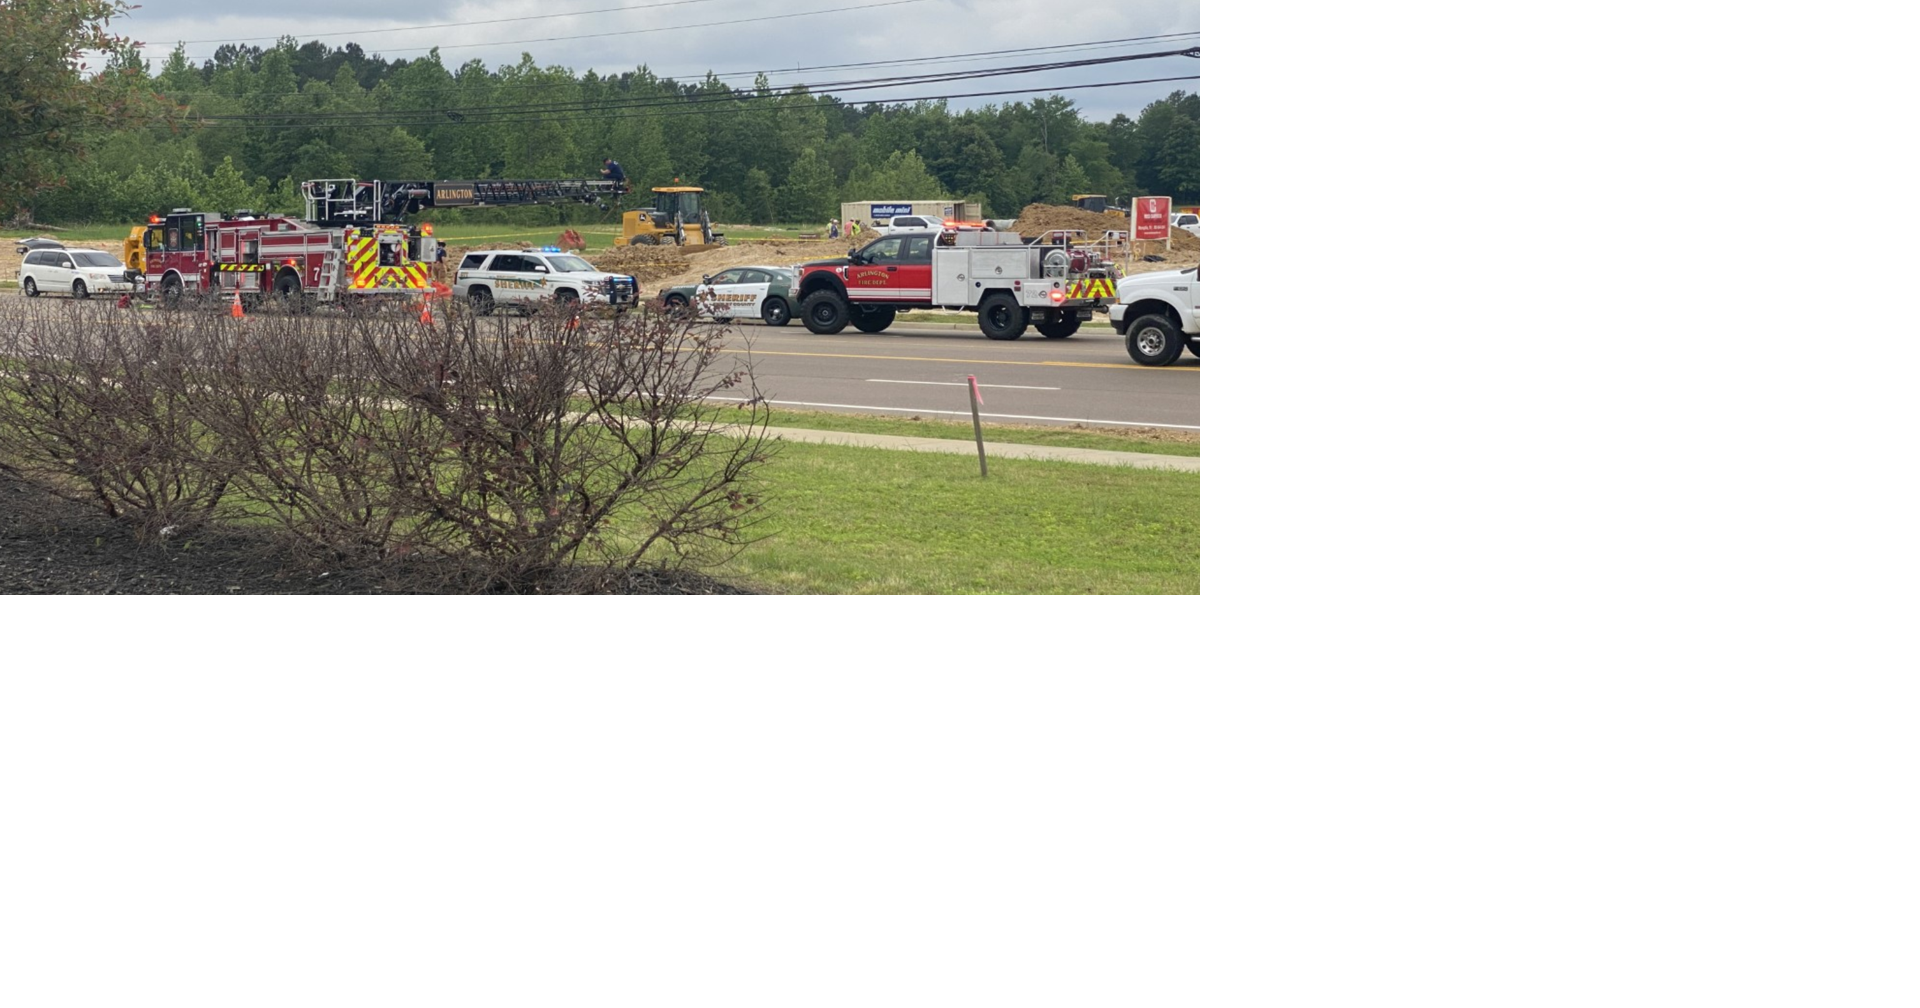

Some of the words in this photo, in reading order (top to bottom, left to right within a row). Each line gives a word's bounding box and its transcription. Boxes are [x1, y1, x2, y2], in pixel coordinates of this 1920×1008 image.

[437, 189, 473, 199] ARLINGTON
[872, 205, 895, 214] mobile
[895, 205, 911, 214] mini
[313, 267, 320, 281] 7
[857, 270, 889, 279] ARLINGTON
[495, 280, 535, 290] SHERIFF
